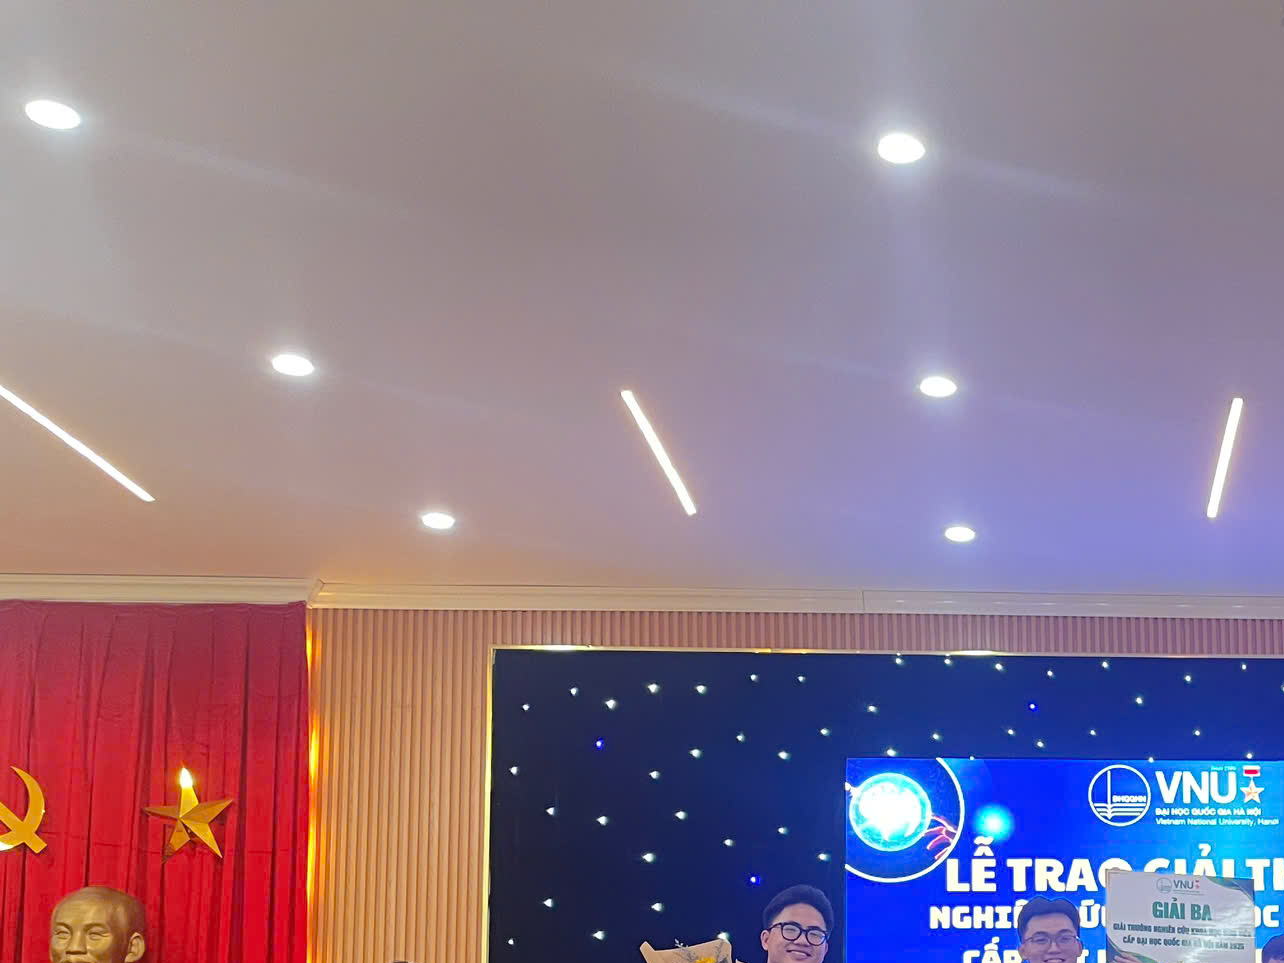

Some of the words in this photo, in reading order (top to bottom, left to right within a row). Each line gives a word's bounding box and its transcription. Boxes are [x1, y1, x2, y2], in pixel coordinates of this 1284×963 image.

[1155, 771, 1238, 804] VNU
[946, 836, 997, 892] LỄ
[1174, 880, 1194, 889] VNU
[1152, 898, 1185, 919] GIẢI
[1191, 904, 1212, 921] BA
